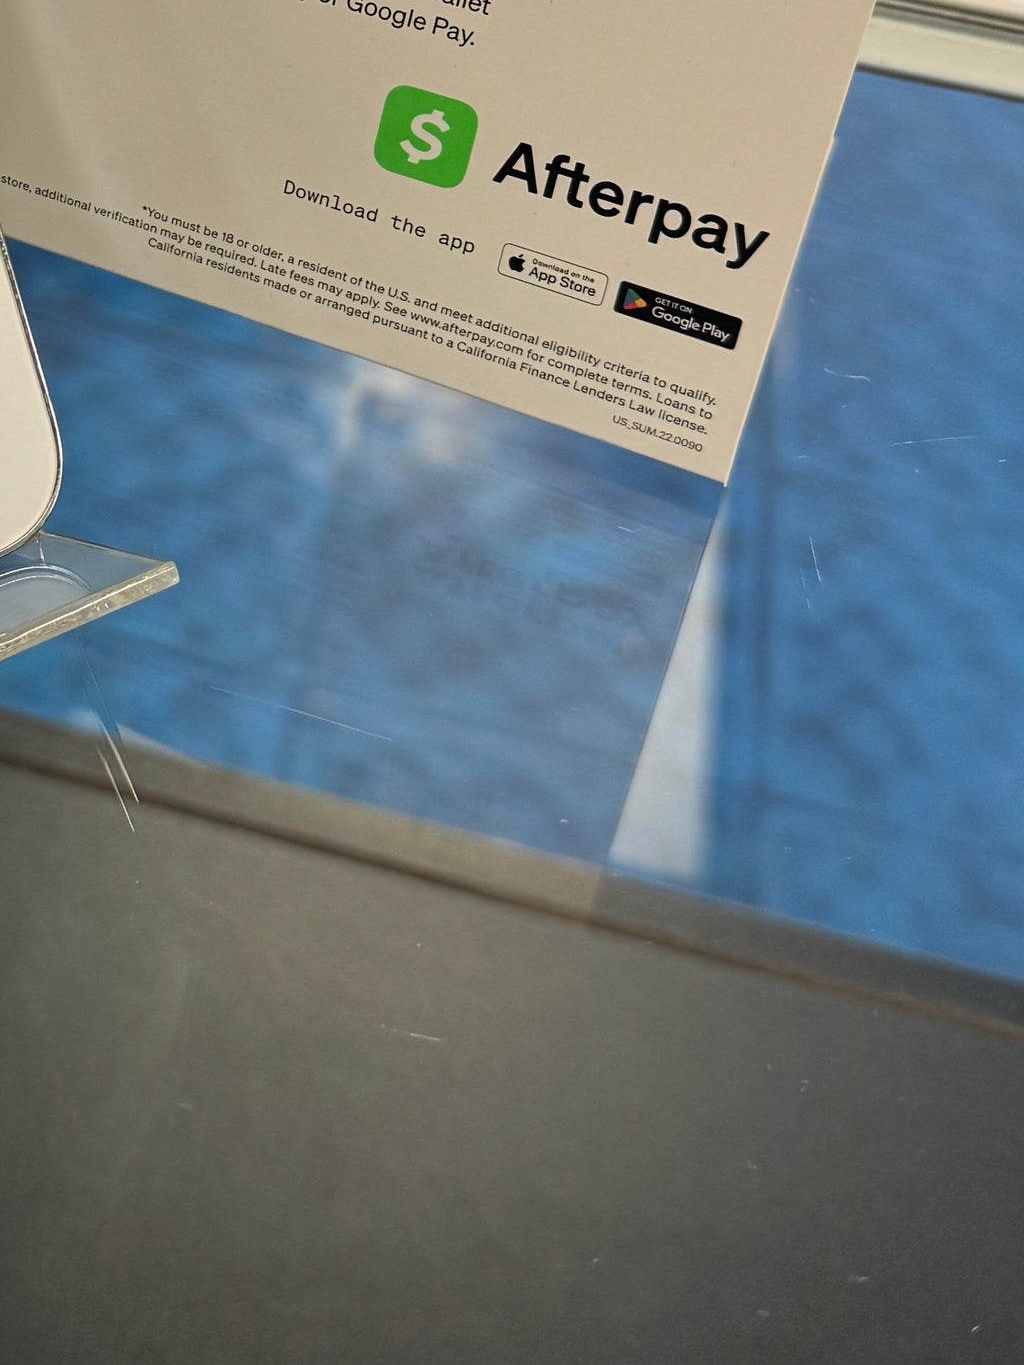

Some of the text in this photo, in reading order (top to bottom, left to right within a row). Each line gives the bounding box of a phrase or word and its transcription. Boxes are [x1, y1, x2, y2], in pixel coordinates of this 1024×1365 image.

[431, 16, 475, 48] Pay.
[283, 179, 475, 255] Download the app
[492, 142, 771, 270] Afterpay
[34, 186, 92, 212] additional
[93, 206, 158, 234] verification
[159, 228, 186, 244] may
[186, 234, 203, 249] be
[204, 243, 258, 268] required.
[260, 259, 287, 277] Late
[289, 269, 315, 287] fees
[317, 280, 344, 297] may
[344, 290, 381, 310] apply.
[383, 300, 408, 318] See
[410, 311, 524, 357] www.afterpay.com
[526, 348, 546, 363] for
[547, 358, 609, 385] complete
[611, 377, 653, 401] terms.
[655, 392, 697, 415] Loans
[698, 407, 713, 420] to
[170, 217, 201, 234] must
[203, 225, 219, 239] be
[222, 232, 235, 244] 18
[236, 238, 251, 249] or
[251, 244, 285, 263] older,
[287, 255, 295, 265] a
[297, 259, 348, 283] resident
[349, 276, 364, 287] of
[365, 279, 386, 295] the
[387, 286, 411, 304] U.S.
[413, 297, 439, 312] and
[440, 306, 474, 324] meet
[475, 318, 540, 346] additional
[541, 340, 602, 368] eligibility
[603, 361, 651, 384] criteria
[653, 375, 667, 389] to
[669, 383, 717, 406] qualify.
[528, 266, 597, 297] App Store
[651, 305, 731, 343] Google Play
[147, 237, 708, 435] California residents made or arranged pursuant to a California Finance Lenders Law license.
